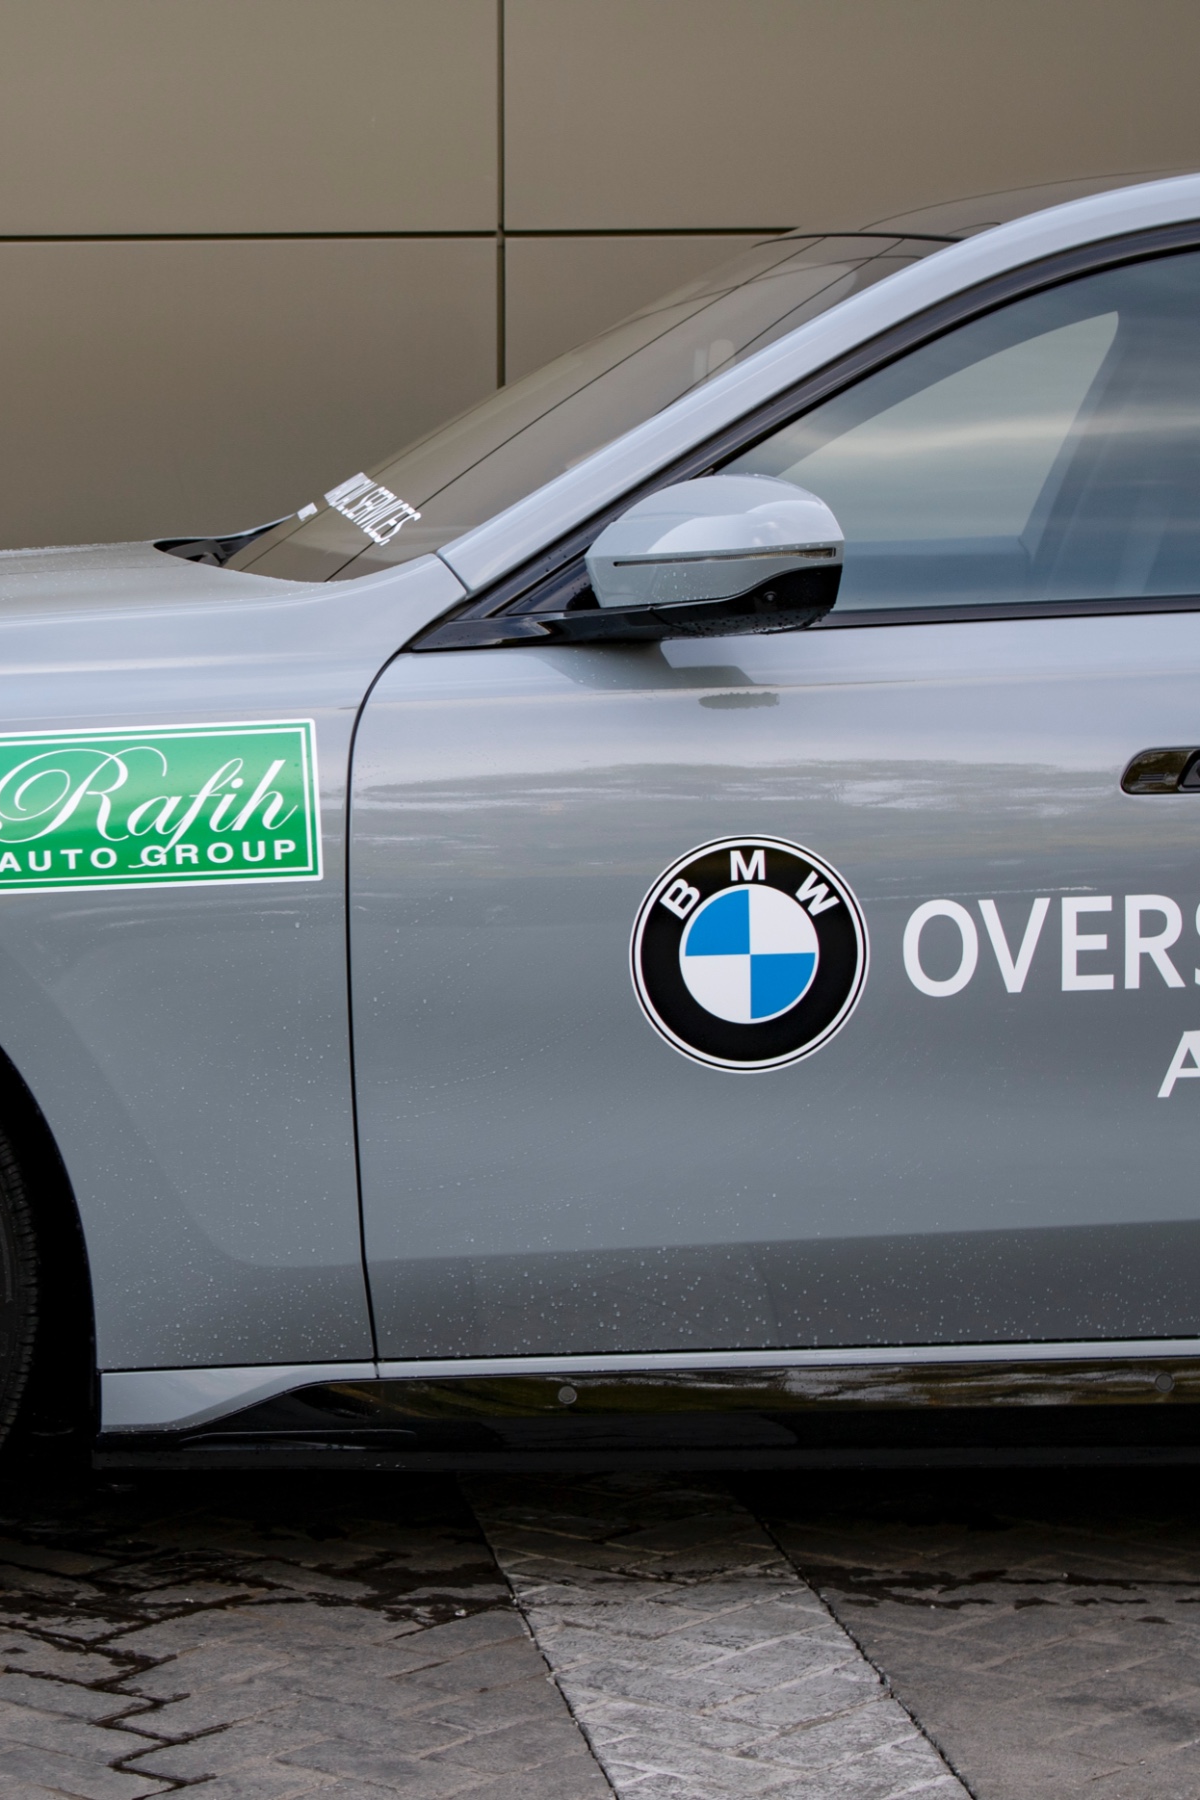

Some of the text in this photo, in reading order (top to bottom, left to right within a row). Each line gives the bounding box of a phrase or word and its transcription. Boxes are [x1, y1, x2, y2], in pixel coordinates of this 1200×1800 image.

[140, 840, 296, 866] GROUP
[659, 850, 841, 920] BMW
[902, 894, 1200, 998] OVER
[1157, 1030, 1200, 1098] A
